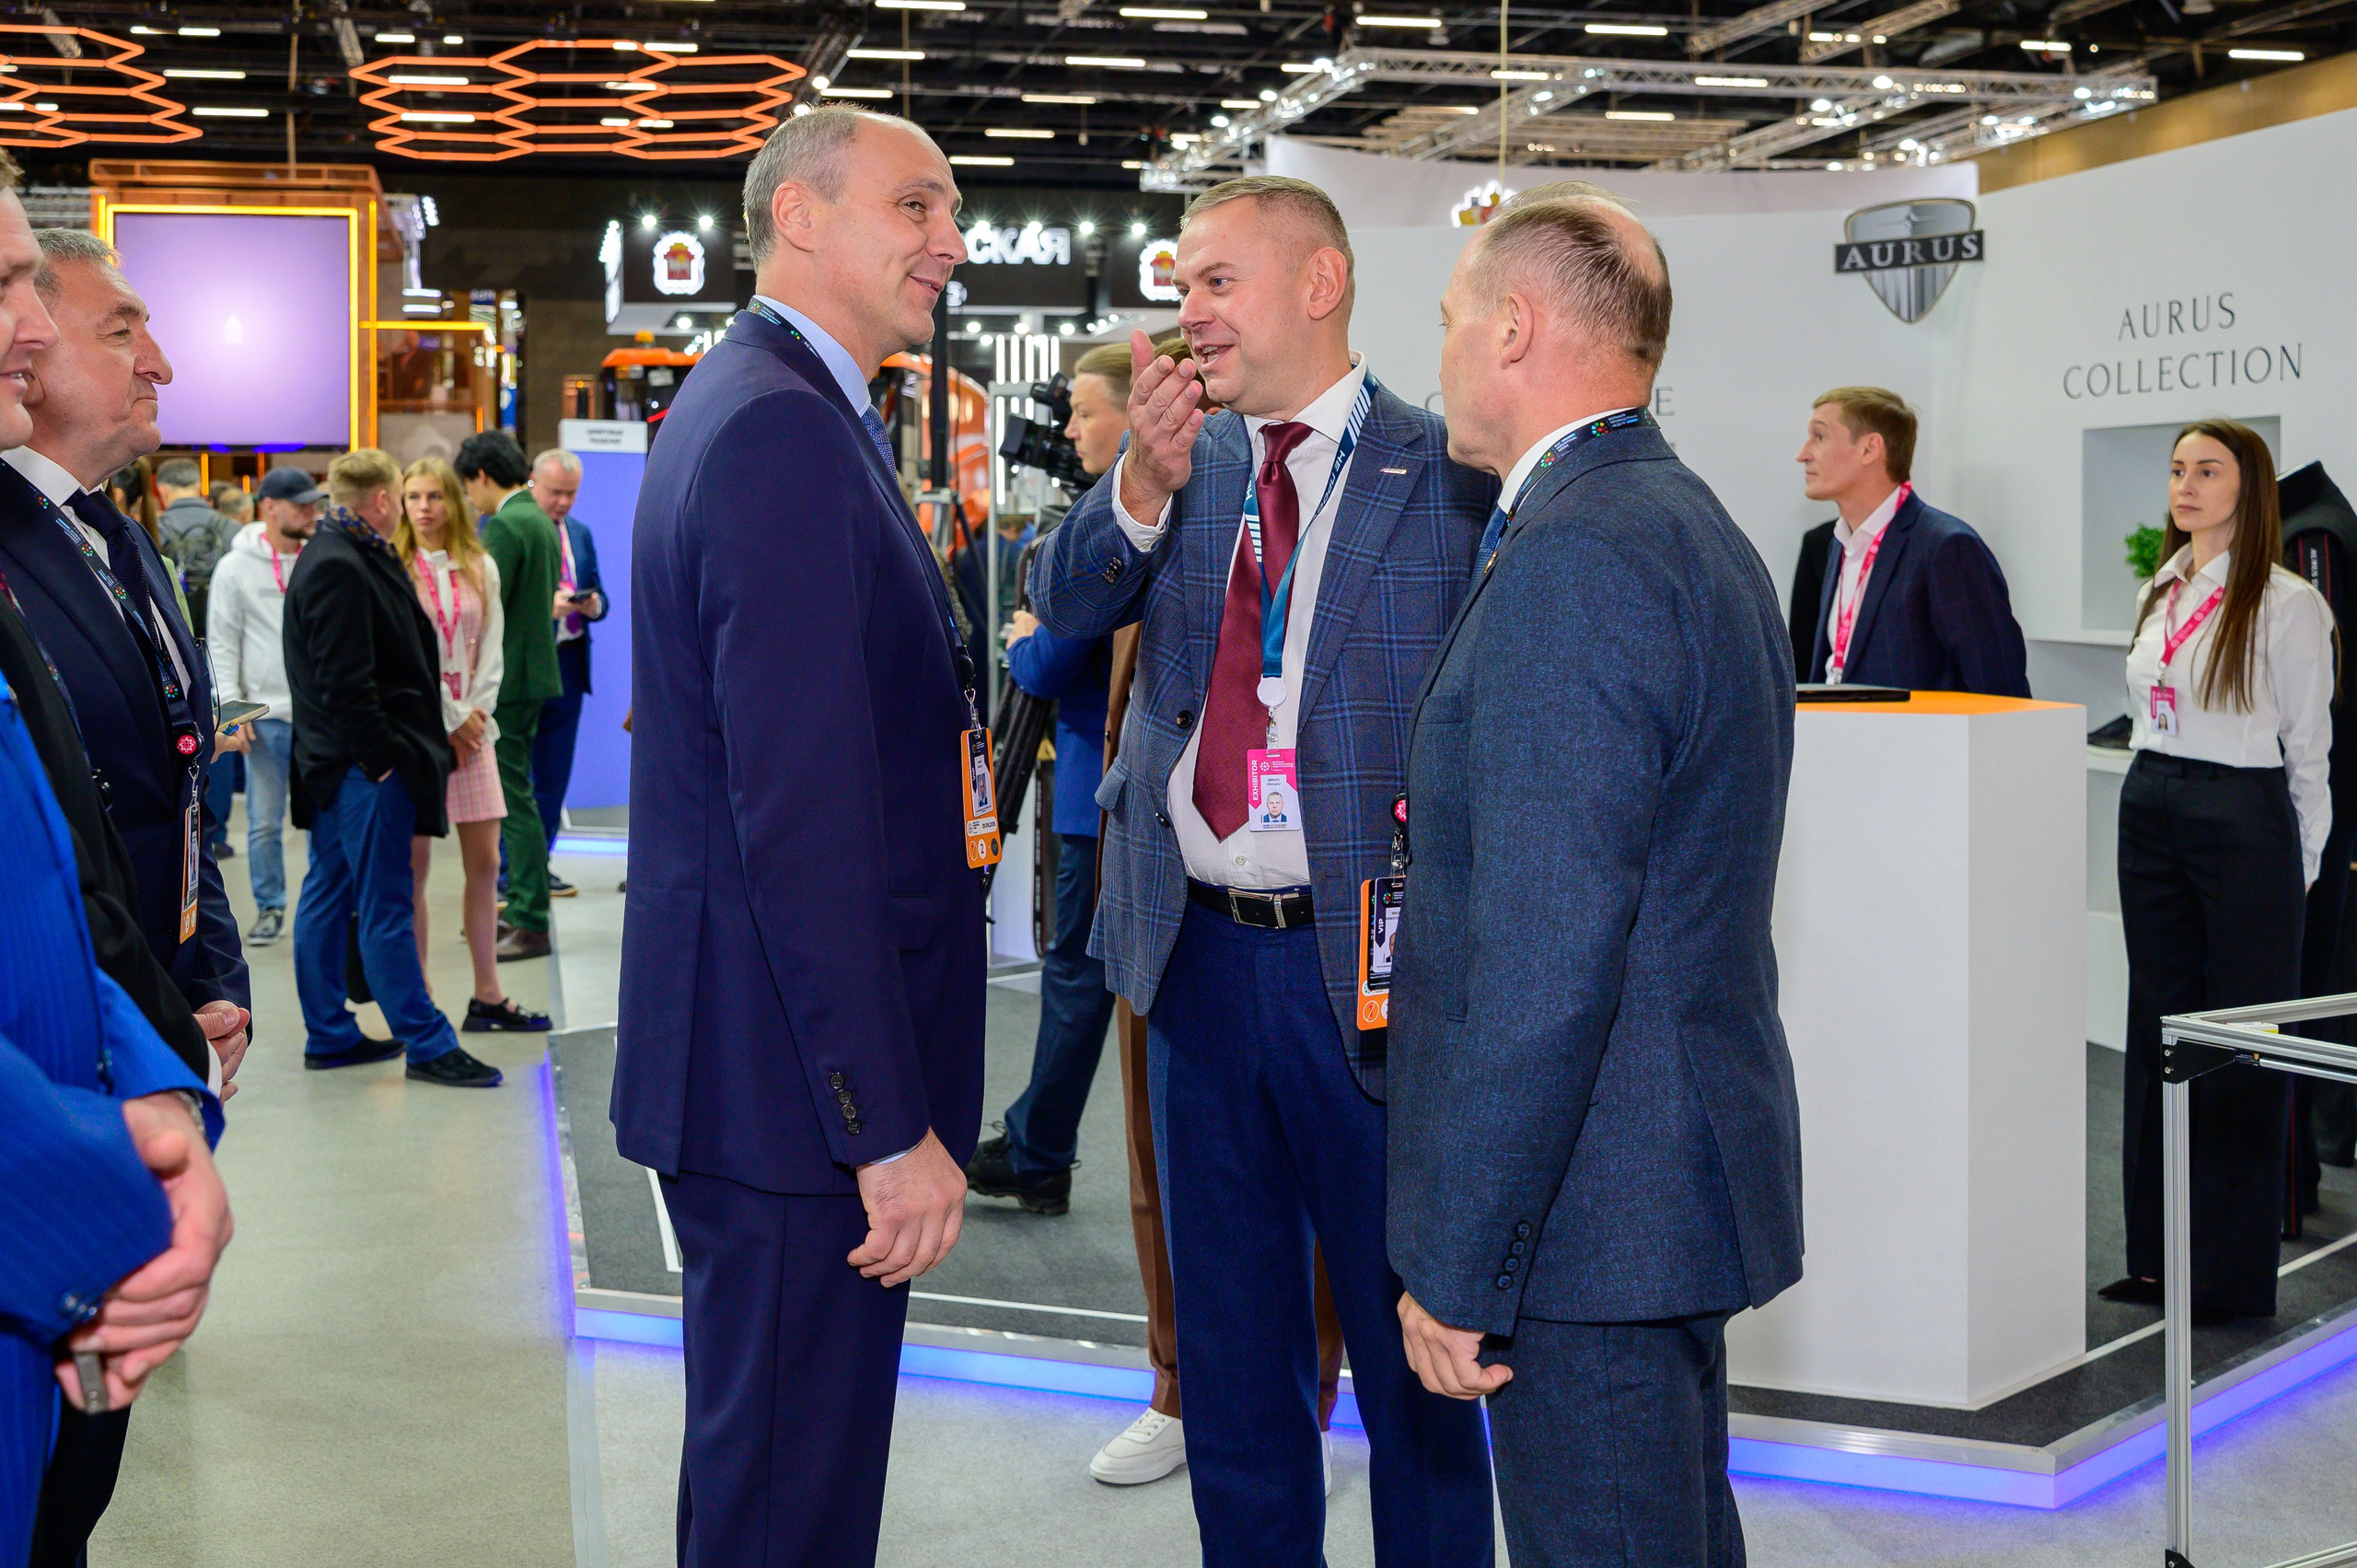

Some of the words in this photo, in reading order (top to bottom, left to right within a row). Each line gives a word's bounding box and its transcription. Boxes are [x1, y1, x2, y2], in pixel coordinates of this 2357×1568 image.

[1842, 234, 1980, 270] AURUS
[2118, 291, 2236, 342] AURUS
[2062, 342, 2304, 400] COLLECTION
[981, 843, 984, 854] 2
